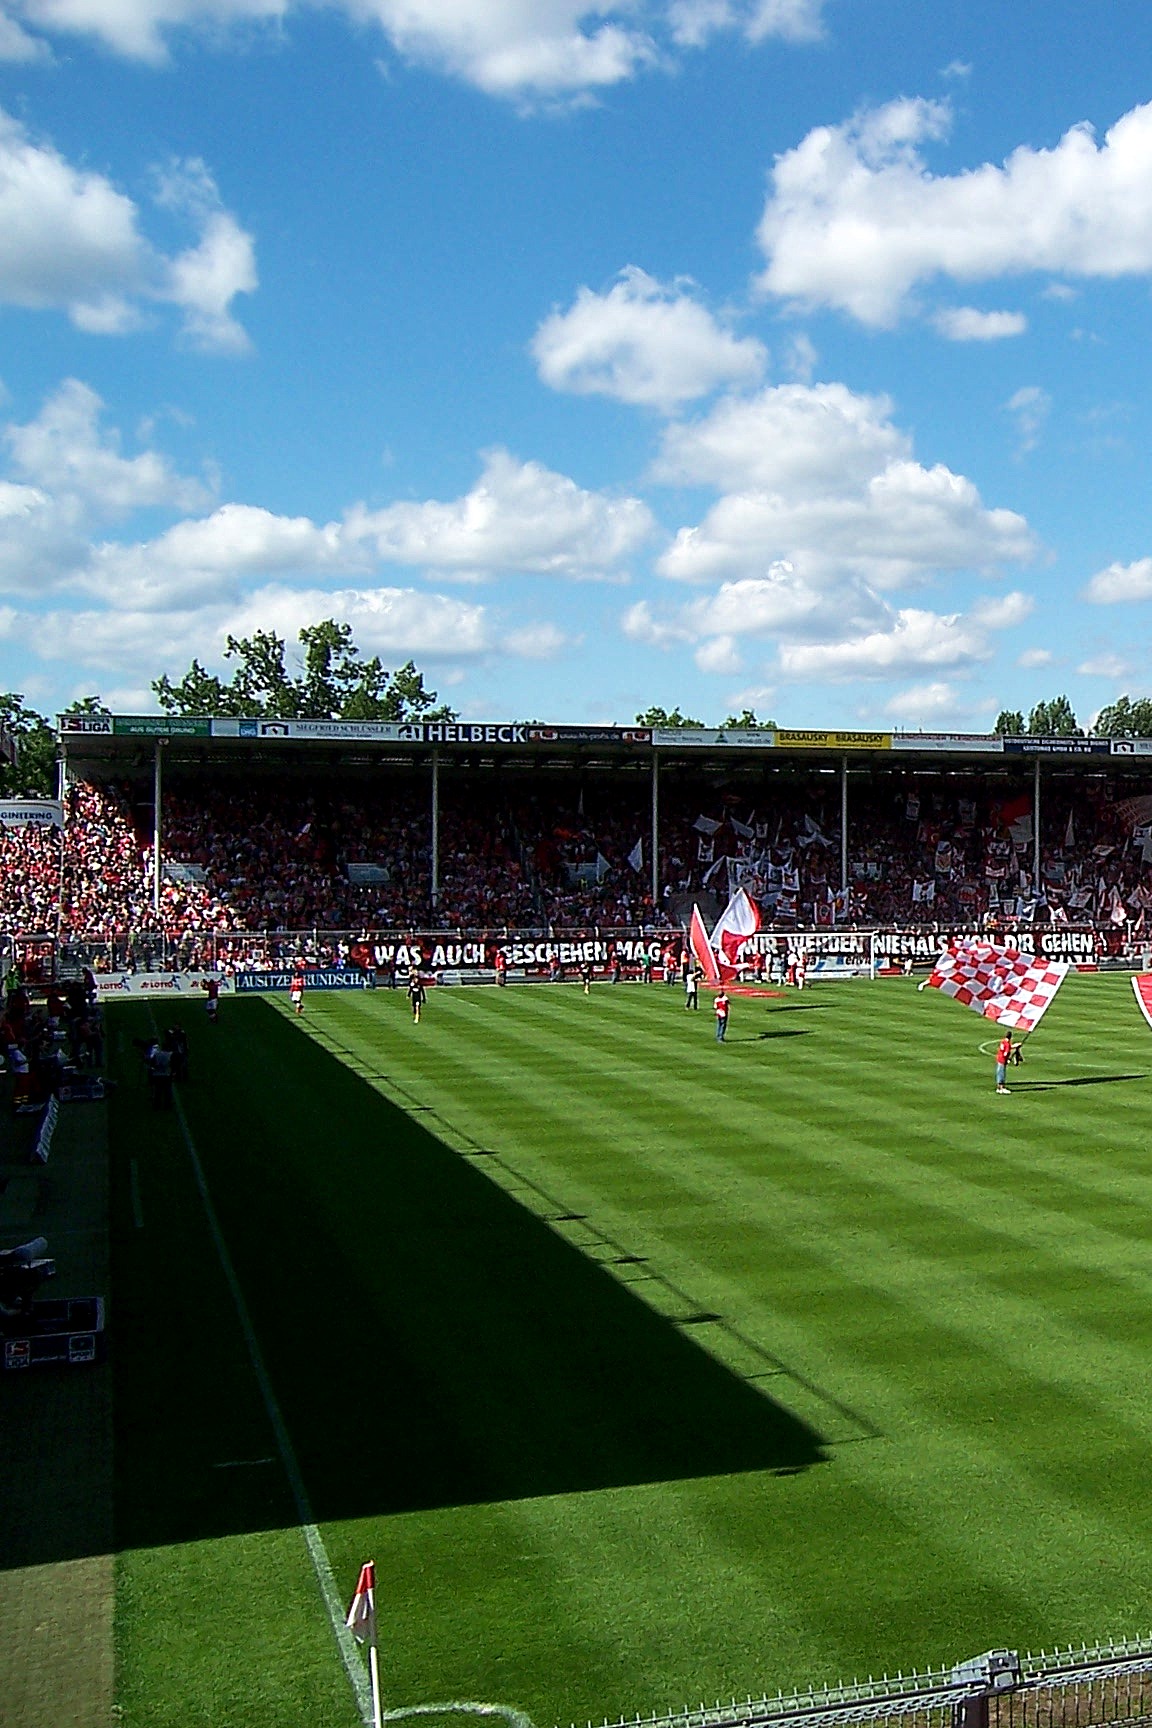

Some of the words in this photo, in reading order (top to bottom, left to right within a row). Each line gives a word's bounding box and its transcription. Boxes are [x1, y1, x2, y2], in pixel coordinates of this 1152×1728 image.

[82, 721, 111, 733] LIGA
[427, 725, 526, 743] HELBECK
[874, 934, 949, 955] NIEMALS
[1004, 934, 1036, 953] DIR
[1041, 933, 1094, 953] GEHEN
[374, 944, 423, 966] WAS
[431, 943, 486, 966] AUCH
[616, 941, 662, 962] MAG
[100, 982, 123, 990] LOTTO
[150, 980, 173, 988] LOTTO
[236, 974, 297, 988] LAUSITZE
